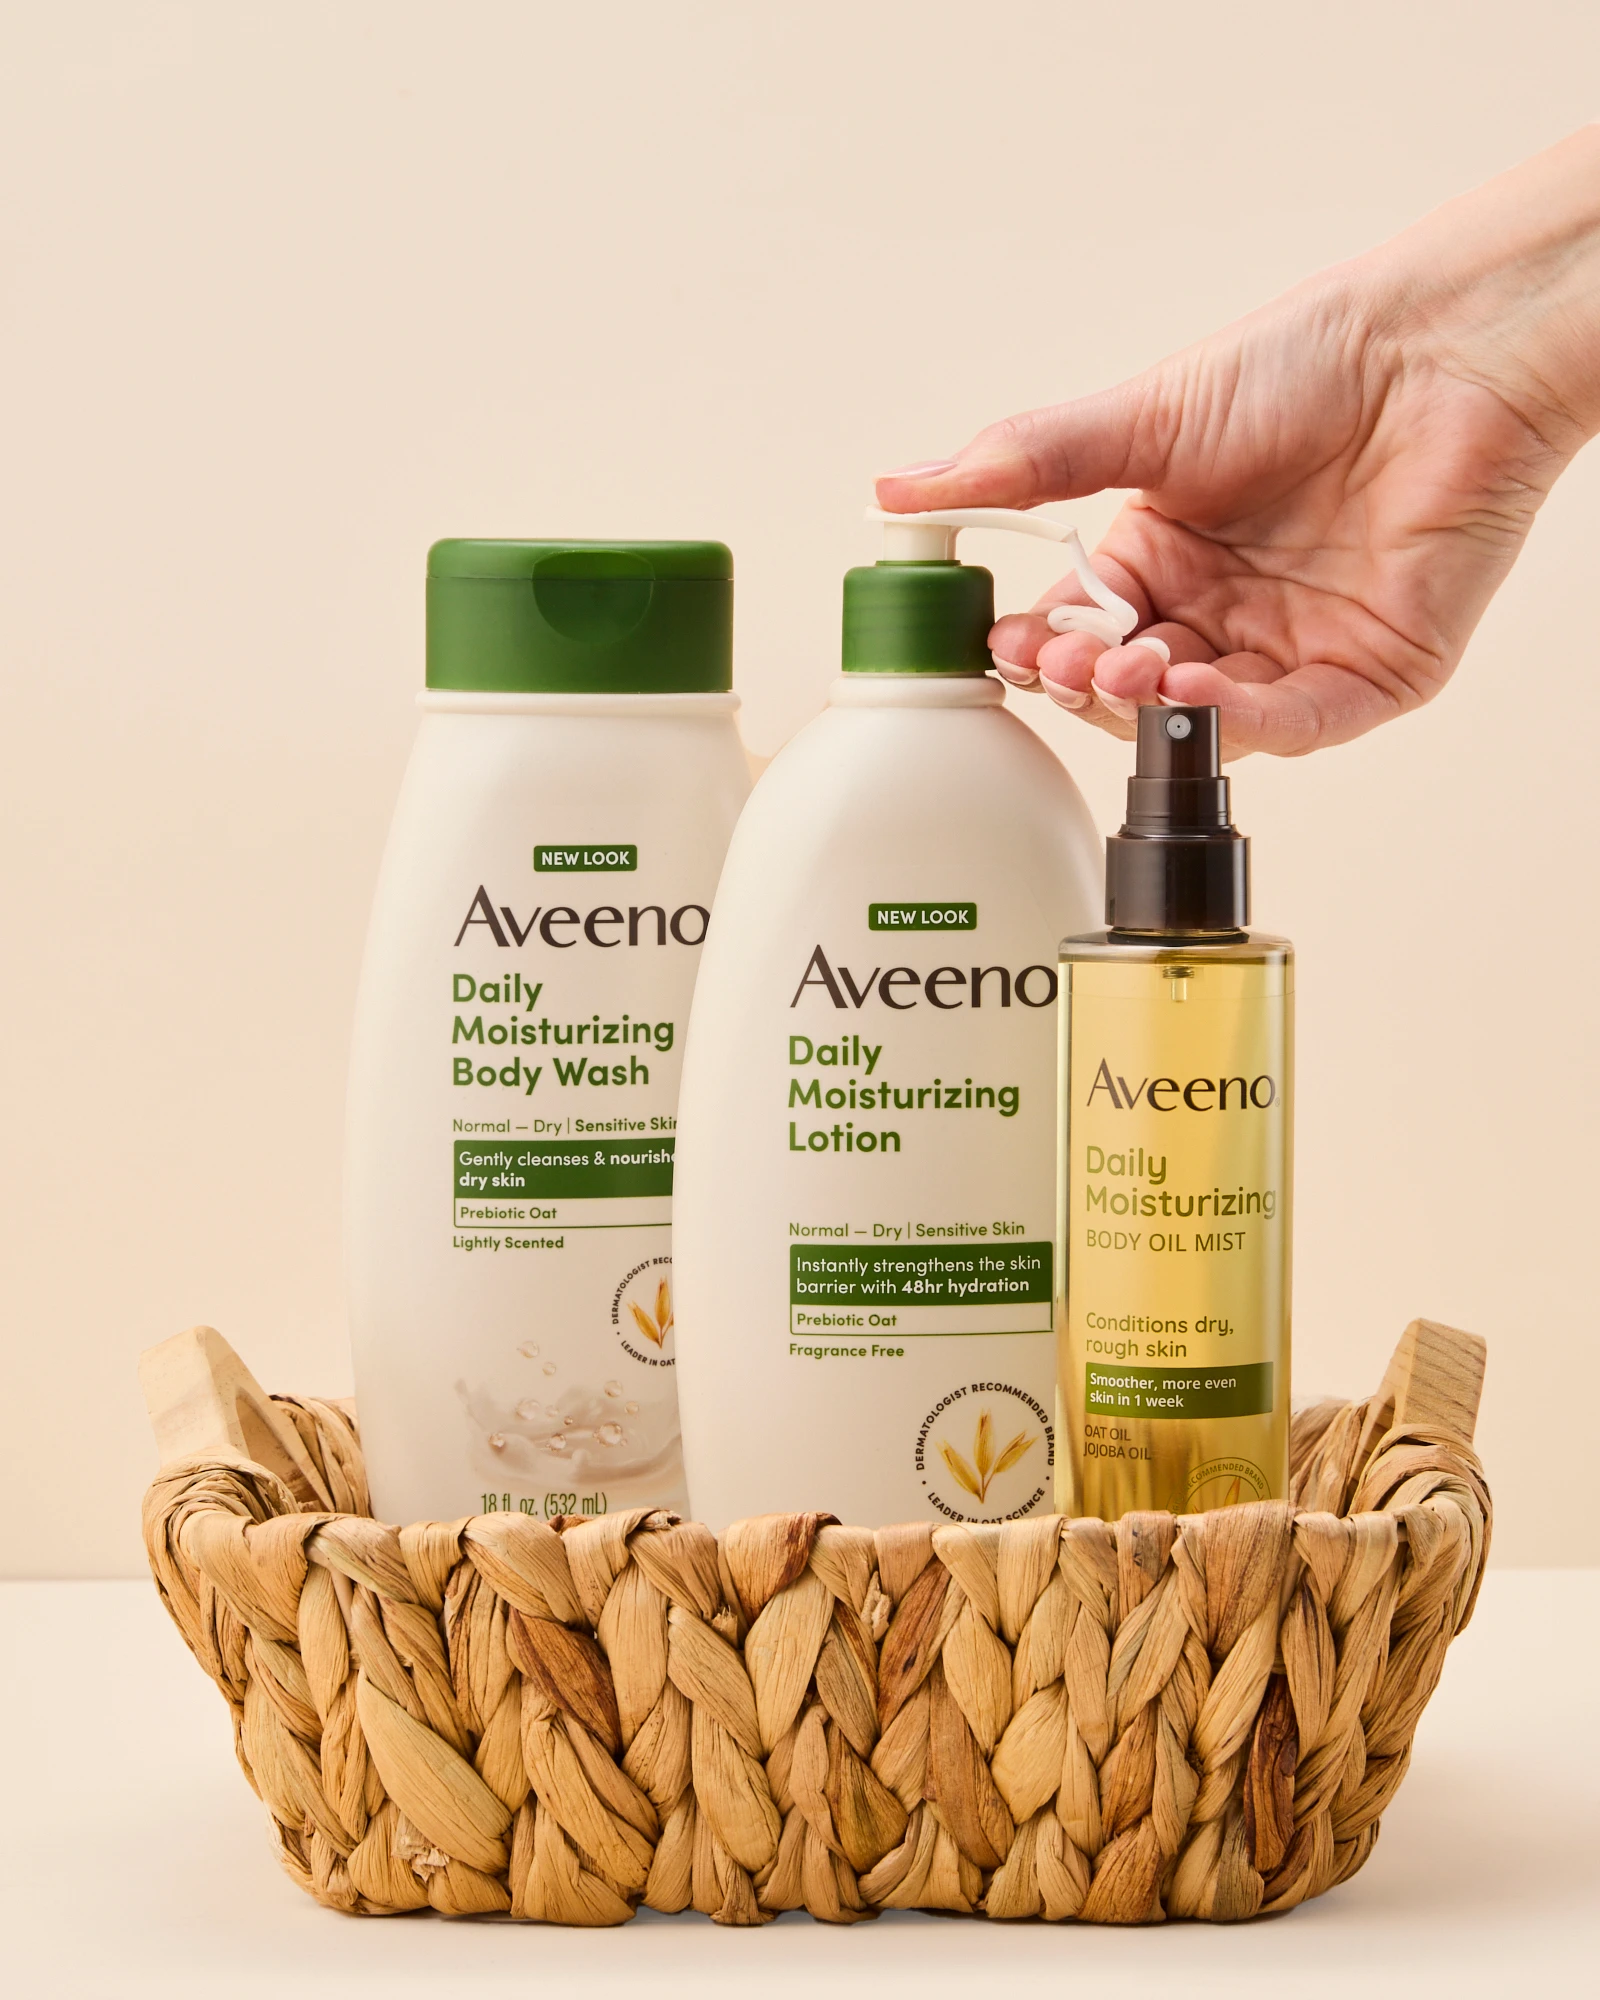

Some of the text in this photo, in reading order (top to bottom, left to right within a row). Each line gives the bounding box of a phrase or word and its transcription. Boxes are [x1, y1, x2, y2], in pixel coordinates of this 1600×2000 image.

[542, 851, 630, 866] NEW LOOK
[454, 885, 710, 948] Aveeno
[878, 910, 969, 925] NEW LOOK
[790, 944, 1058, 1009] Aveeno
[453, 973, 543, 1012] Daily
[452, 1015, 674, 1052] Moisturizing
[789, 1035, 882, 1075] Daily
[453, 1056, 649, 1095] Body Wash
[1086, 1057, 1276, 1112] Aveeno
[788, 1078, 1020, 1117] Moisturizing
[453, 1119, 510, 1133] Normal
[535, 1119, 562, 1137] Dry
[576, 1117, 646, 1133] Sensitive
[789, 1121, 901, 1152] Lotion
[460, 1151, 513, 1170] Gently
[518, 1151, 589, 1167] cleanses
[594, 1151, 606, 1166] &
[1086, 1145, 1167, 1186] Daily
[460, 1171, 525, 1190] dry skin
[460, 1206, 557, 1219] Prebiotic Oat
[1086, 1184, 1277, 1220] Moisturizing
[453, 1235, 564, 1251] Lightly Scented
[789, 1222, 849, 1238] Normal
[873, 1223, 902, 1241] Dry
[916, 1222, 988, 1238] Sensitive
[993, 1221, 1025, 1236] Skin
[1086, 1229, 1246, 1252] BODY OIL MIST
[797, 1255, 1041, 1277] Instantly strengthens the skin
[611, 1260, 650, 1325] DERMATOLOGIST
[797, 1277, 1030, 1297] barrier with 48hr hydration
[797, 1313, 897, 1327] Prebiotic Oat
[1086, 1311, 1234, 1336] Conditions dry,
[621, 1340, 676, 1367] LEADER IN OAT
[789, 1343, 905, 1359] Fragrance Free
[1086, 1338, 1187, 1360] rough skin
[1090, 1372, 1237, 1392] Smoother, more even
[1090, 1390, 1185, 1408] skin in 1 week
[915, 1382, 1055, 1471] DERMATOLOGIST RECOMMENDED BRAND
[1084, 1424, 1132, 1442] OAT OIL
[1083, 1442, 1153, 1461] JOJOBA OIL
[1187, 1463, 1264, 1490] ECOMMENDED BRAND
[482, 1492, 608, 1520] 18 fl oz. (532 mL)
[928, 1492, 965, 1522] LEADER
[1006, 1487, 1046, 1520] SCIENCE
